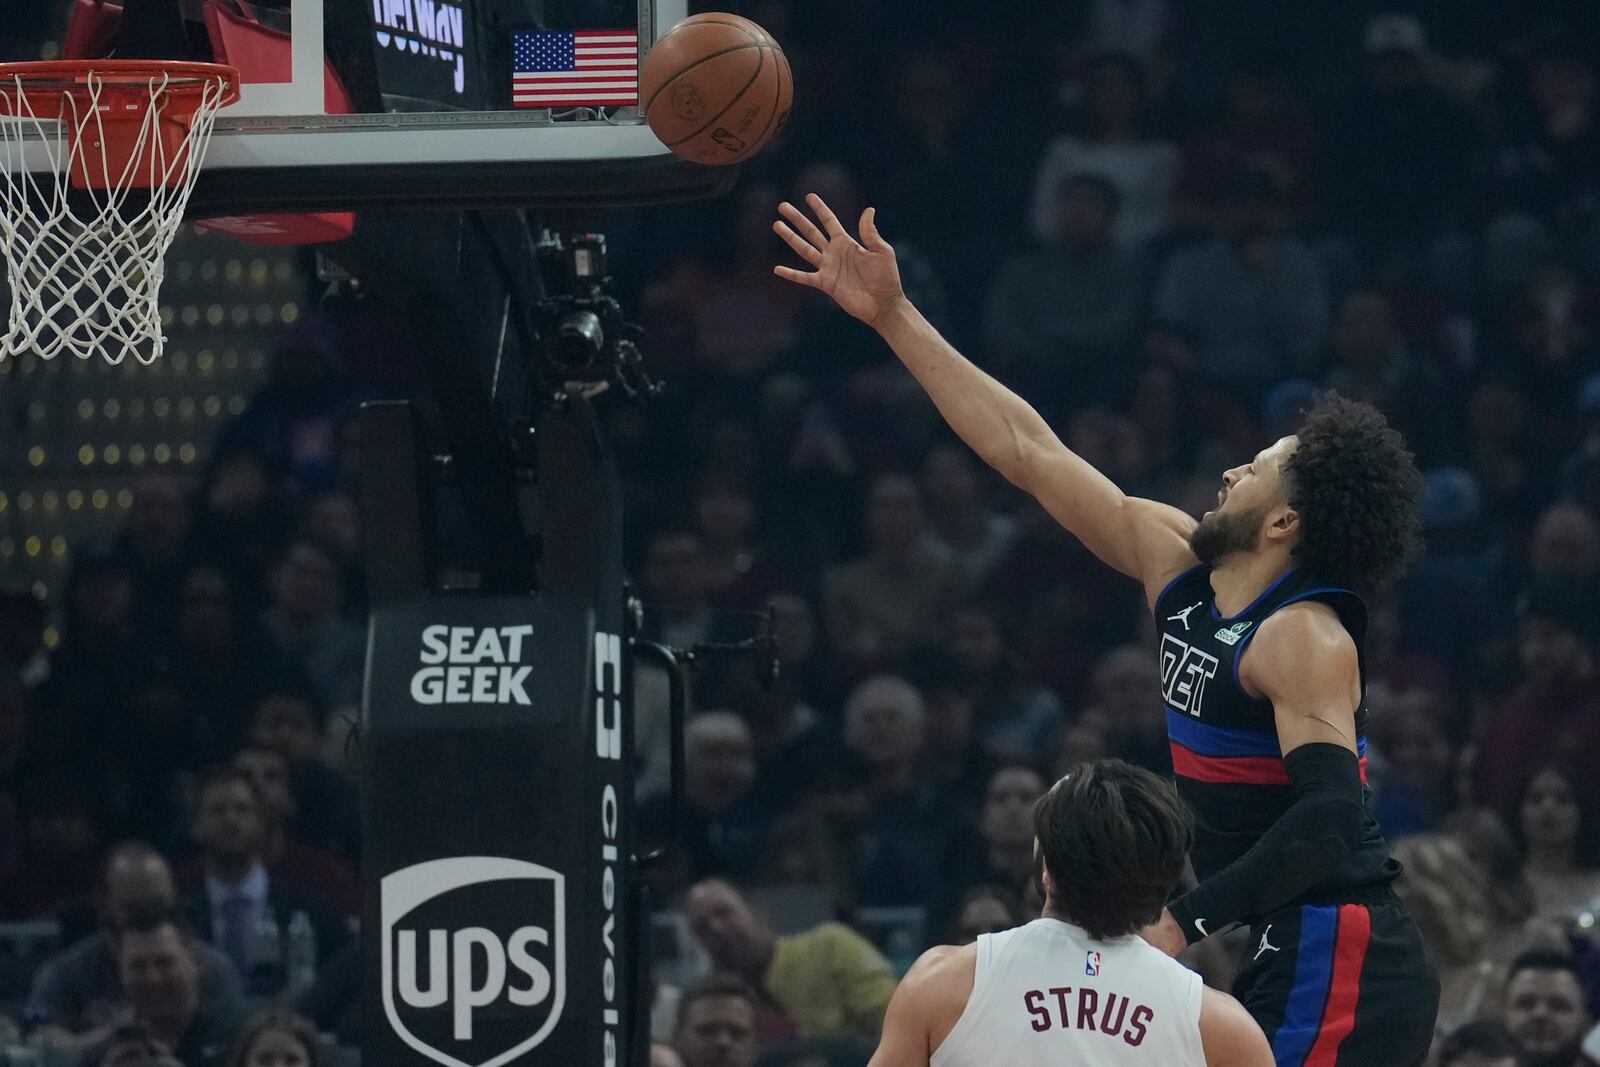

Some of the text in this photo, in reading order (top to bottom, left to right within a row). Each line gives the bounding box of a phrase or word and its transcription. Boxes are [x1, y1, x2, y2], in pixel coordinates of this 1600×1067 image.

[420, 624, 534, 665] SEAT
[1159, 632, 1219, 717] DET
[409, 665, 534, 706] GEEK
[397, 925, 552, 1041] ups
[1024, 986, 1154, 1047] STRUS
